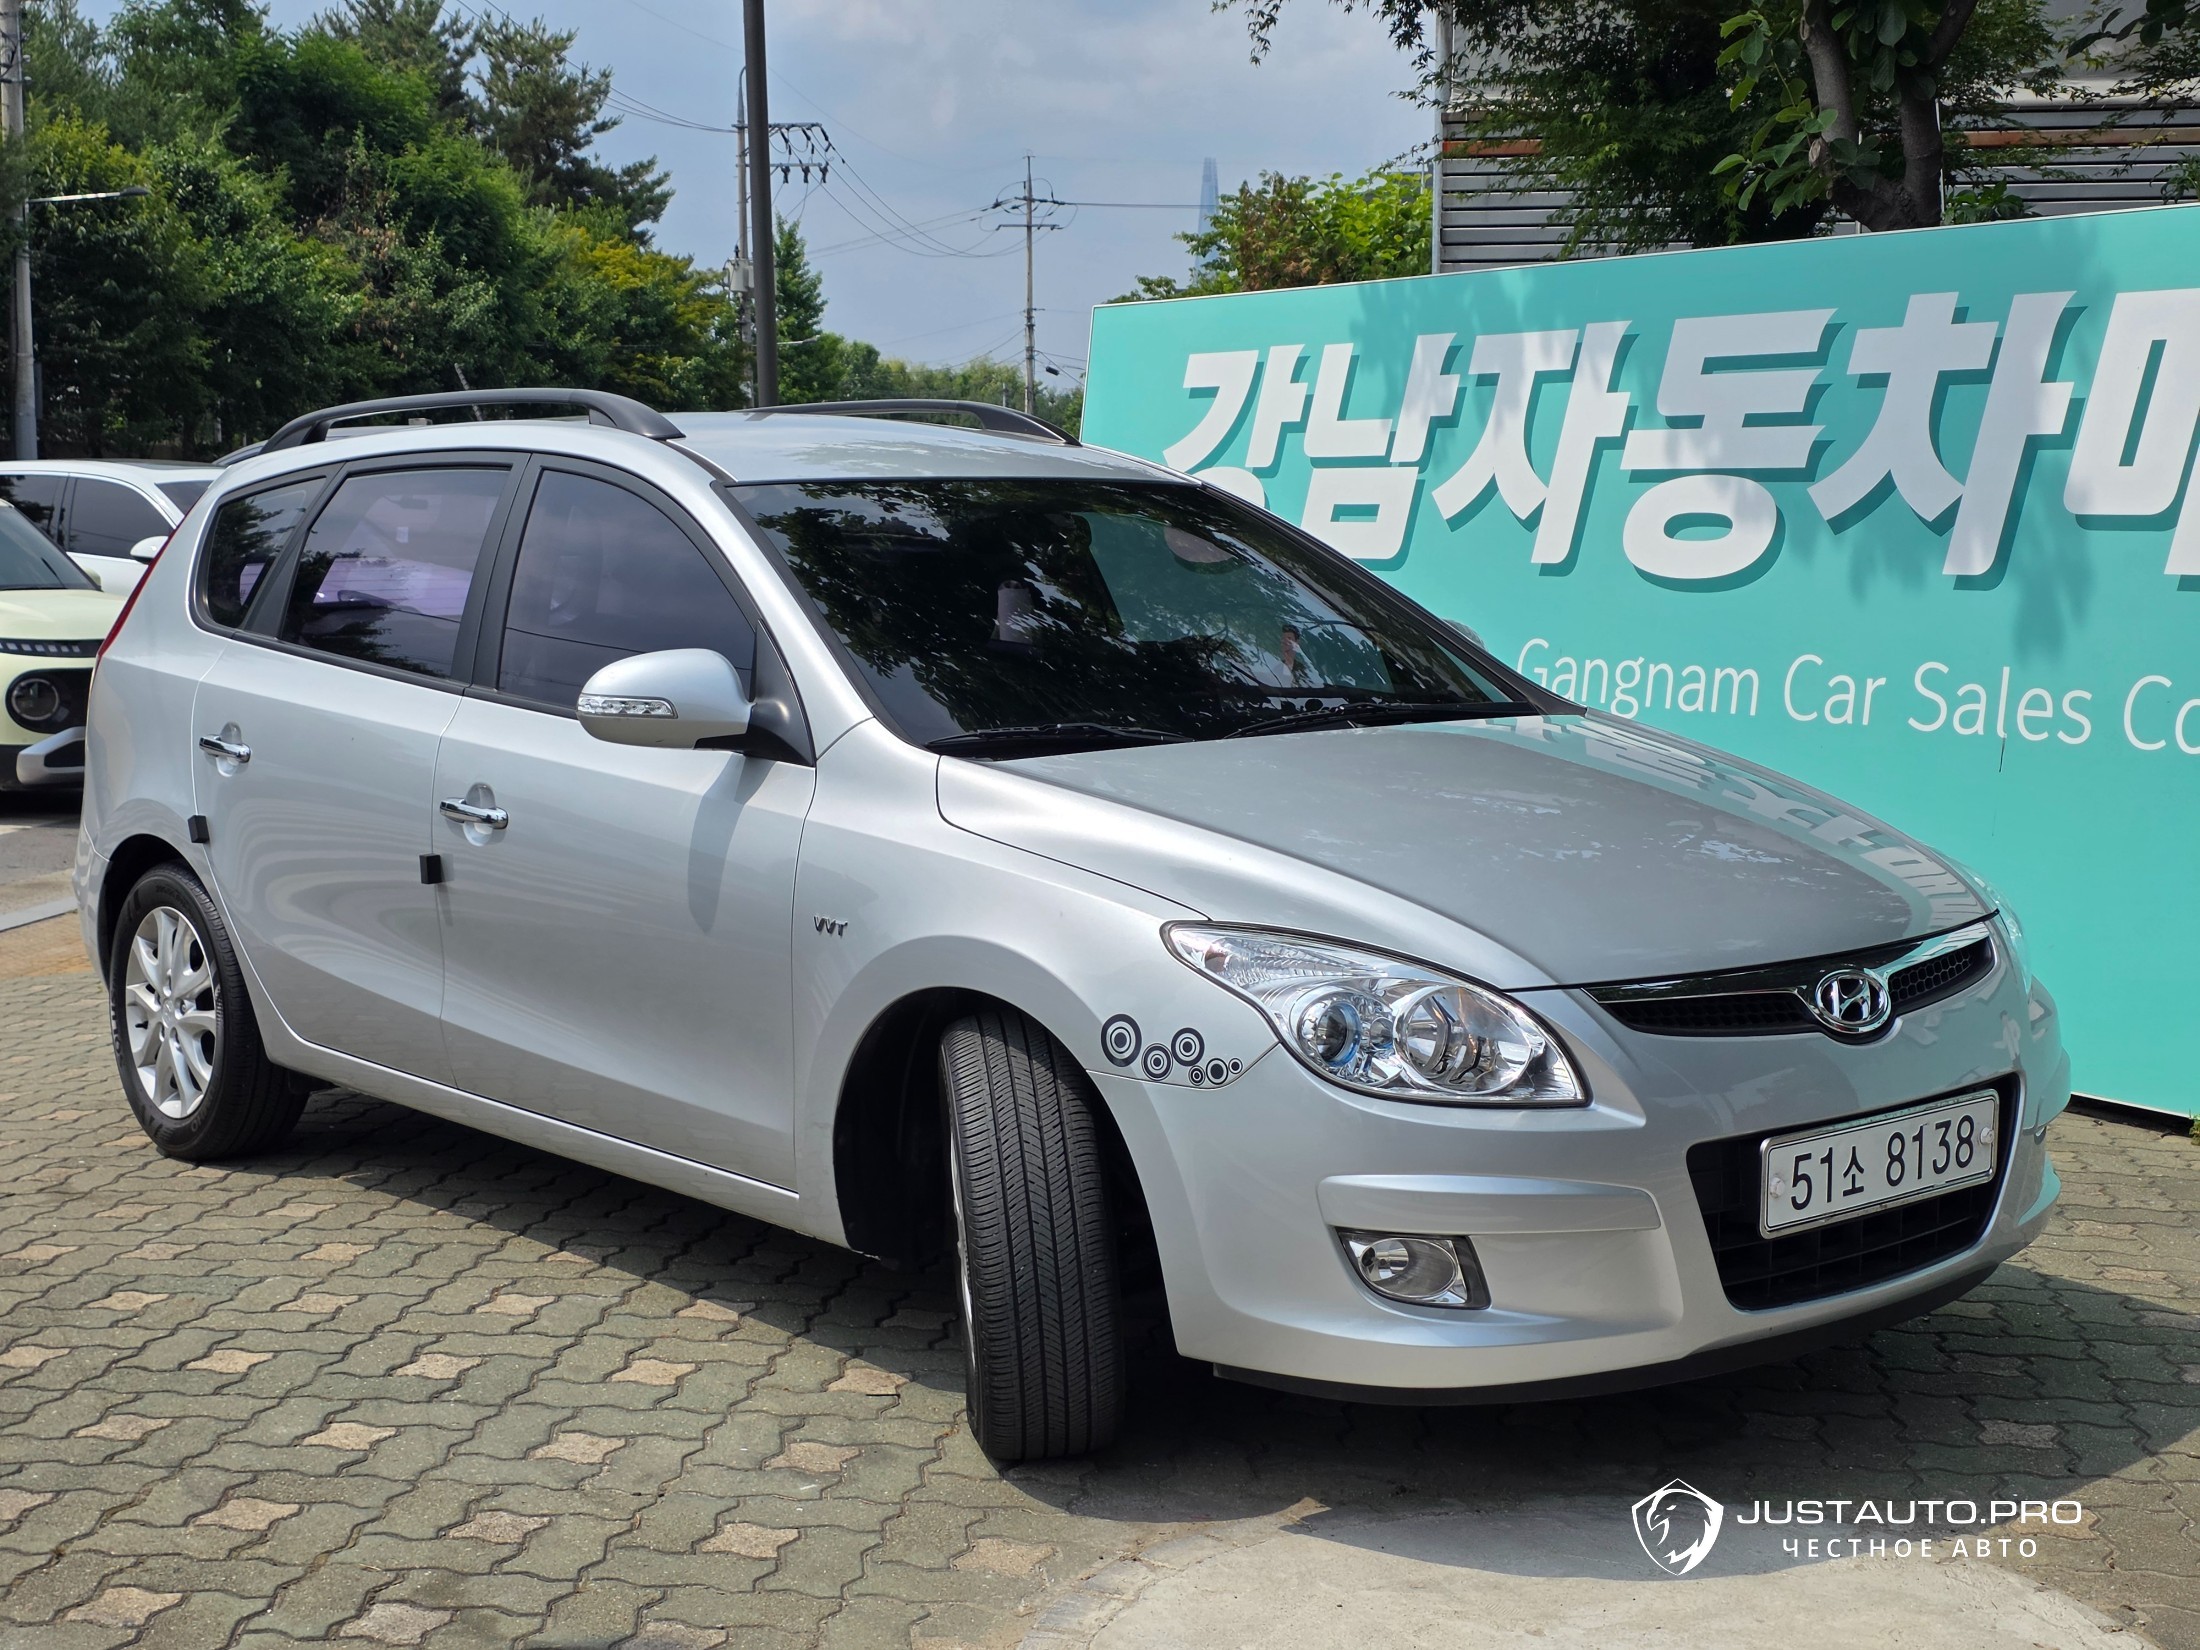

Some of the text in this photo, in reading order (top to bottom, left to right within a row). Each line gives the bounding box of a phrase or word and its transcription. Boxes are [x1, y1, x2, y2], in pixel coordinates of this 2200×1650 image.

[1516, 637, 1760, 720] Gangnam
[1783, 653, 1887, 726] Car
[1907, 660, 2093, 745] Sales
[1790, 1114, 1975, 1211] 51소 8138
